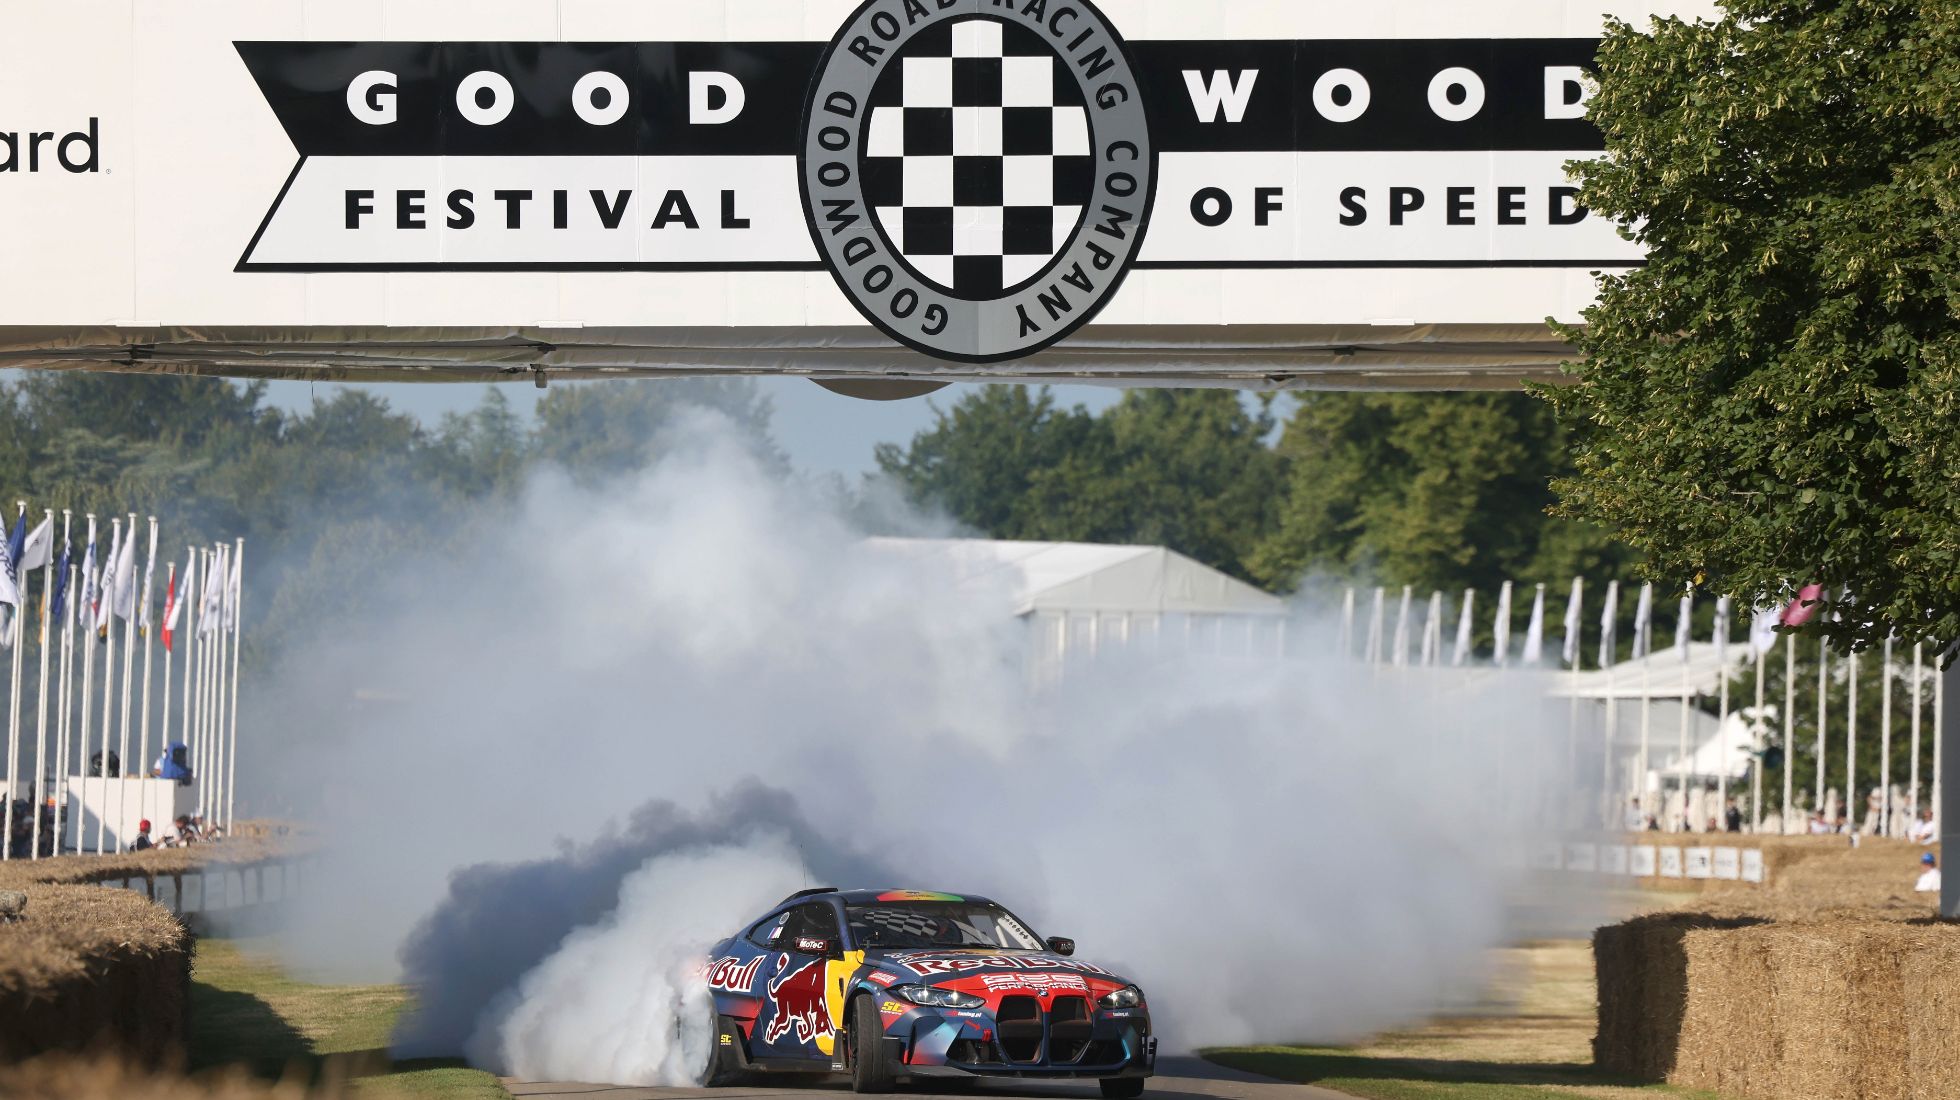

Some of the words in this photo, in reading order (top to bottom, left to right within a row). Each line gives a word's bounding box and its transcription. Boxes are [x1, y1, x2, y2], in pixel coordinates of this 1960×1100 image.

[345, 70, 746, 125] GOOD
[1181, 66, 1598, 123] WOOD
[344, 188, 751, 230] FESTIVAL
[1190, 187, 1284, 227] OF
[1338, 186, 1590, 227] SPEED
[817, 91, 949, 335] GOODWOOD
[1015, 141, 1139, 338] COMPANY
[709, 955, 767, 992] Bull
[901, 956, 1022, 977] Red
